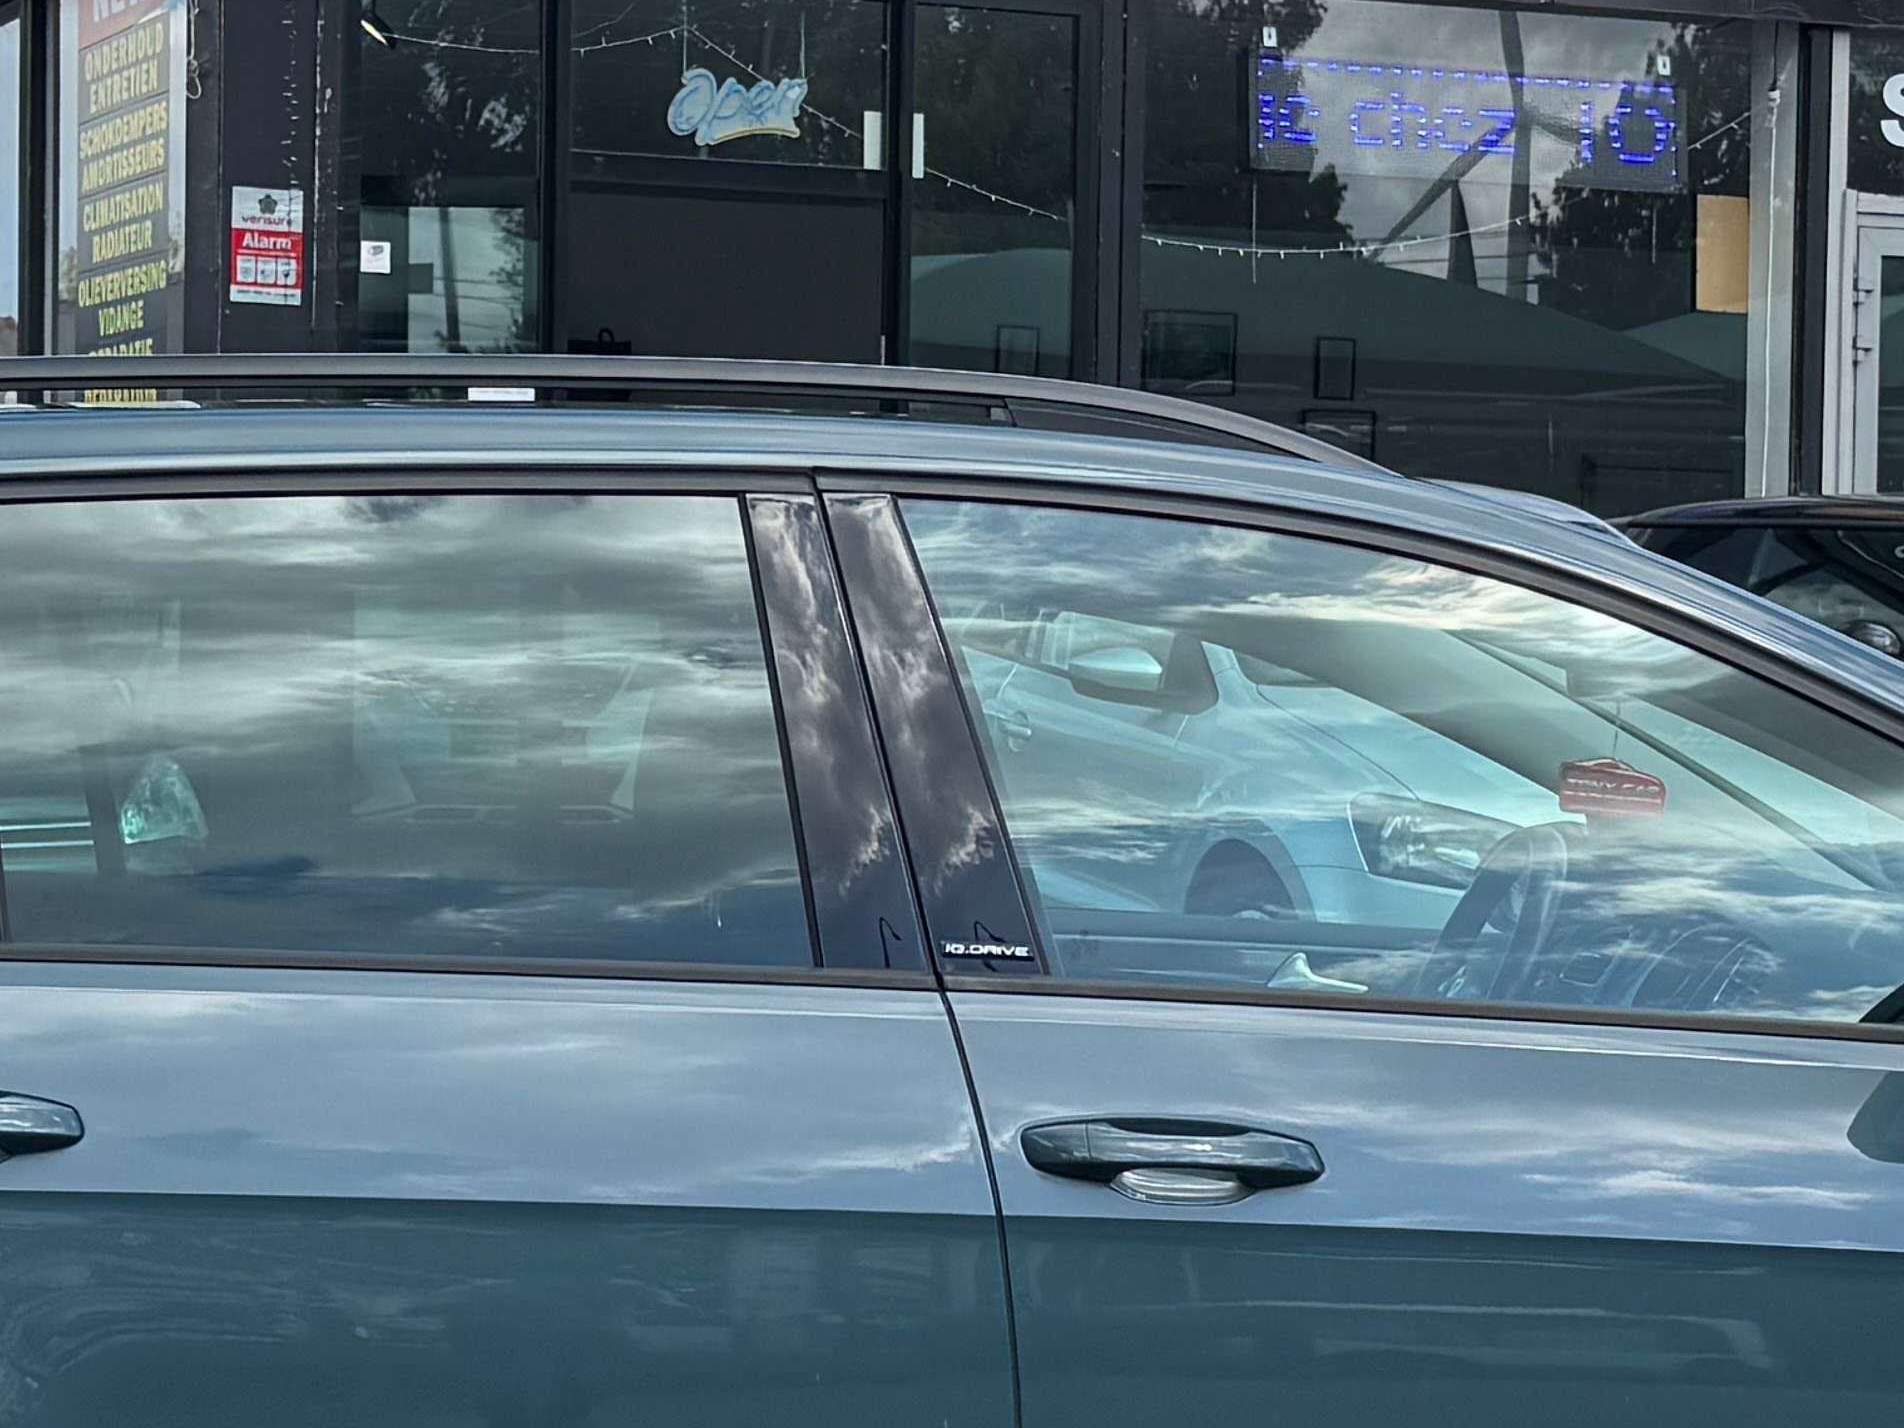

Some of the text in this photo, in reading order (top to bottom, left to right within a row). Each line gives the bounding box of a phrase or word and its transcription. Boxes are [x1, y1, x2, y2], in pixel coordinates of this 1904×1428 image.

[84, 23, 164, 81] ONDERHOUD
[90, 60, 158, 113] ENTRETIEN
[79, 101, 168, 159] SCHOKDEMPERS
[81, 138, 165, 192] AMORTISSEURS
[83, 181, 164, 232] CLIMATISATION
[92, 220, 153, 264] RADIATEUR
[242, 232, 292, 250] Alarm
[78, 259, 167, 307] OLIEVERVERSING
[98, 299, 144, 336] VIDANGE
